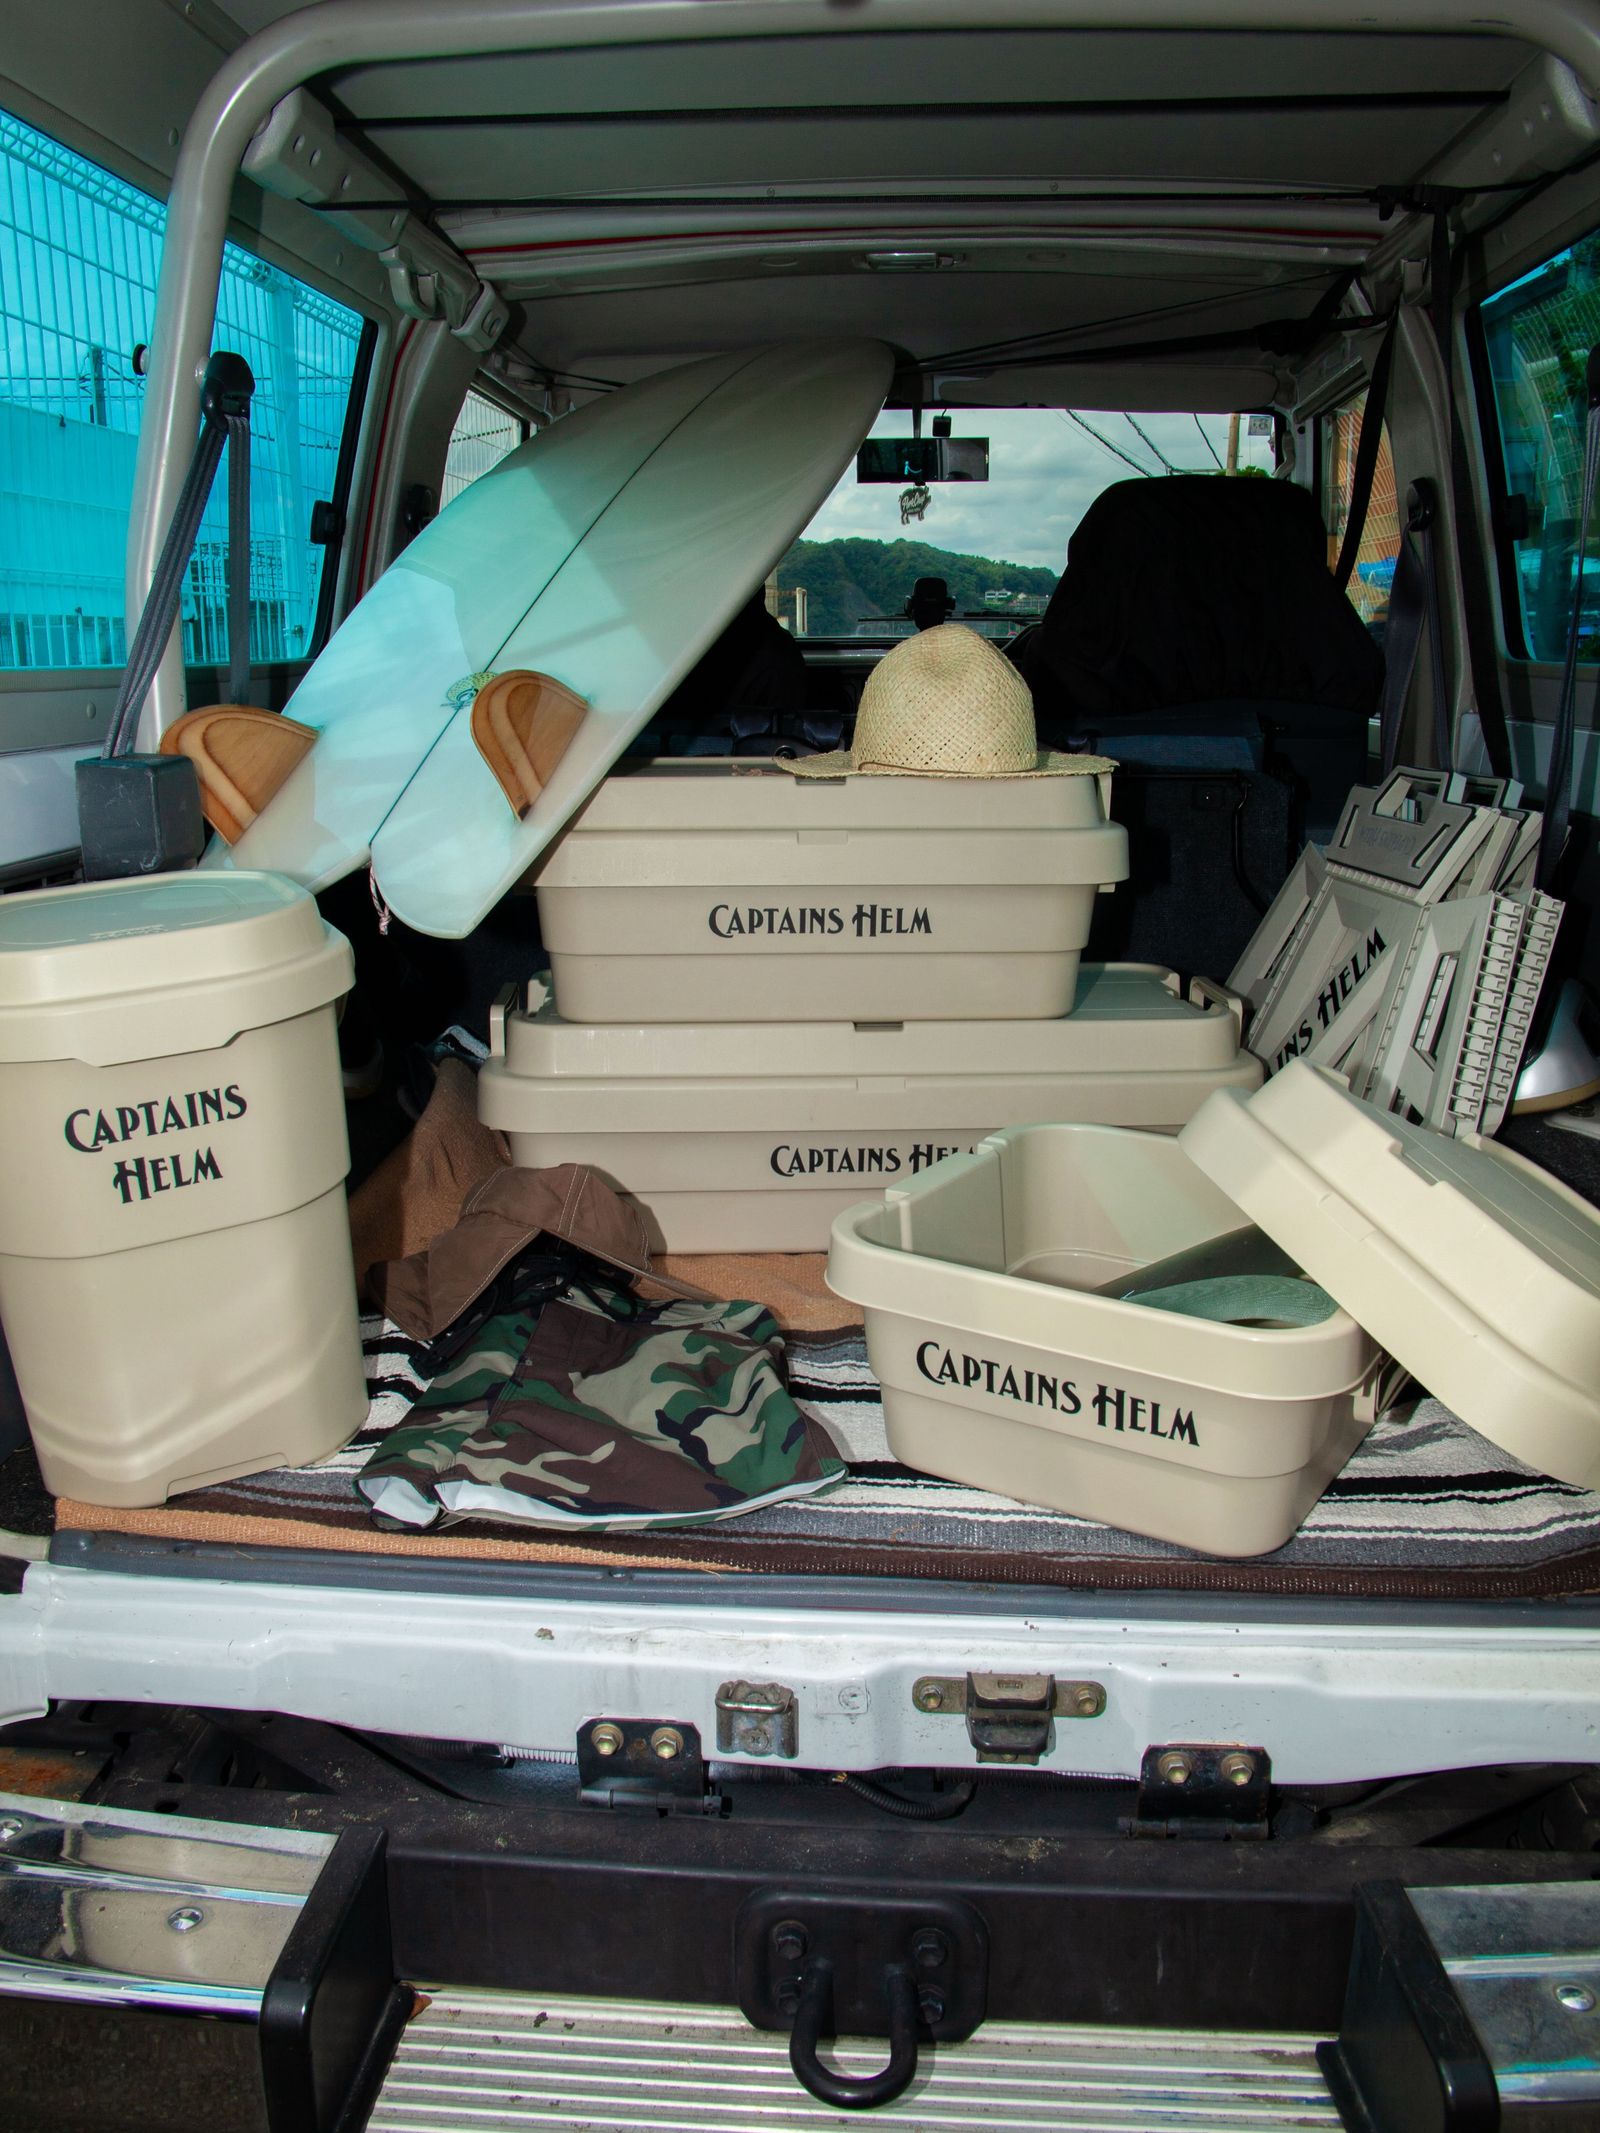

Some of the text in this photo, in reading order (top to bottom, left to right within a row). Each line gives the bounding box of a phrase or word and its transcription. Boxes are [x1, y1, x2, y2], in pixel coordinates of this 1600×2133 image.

[708, 904, 932, 938] CAPTAINS HELM
[1317, 926, 1387, 1030] HELM
[64, 1084, 247, 1153] CAPTAINS
[113, 1146, 224, 1204] HELM
[770, 1145, 901, 1177] CAPTAINS
[916, 1341, 1200, 1447] CAPTAINS HELM
